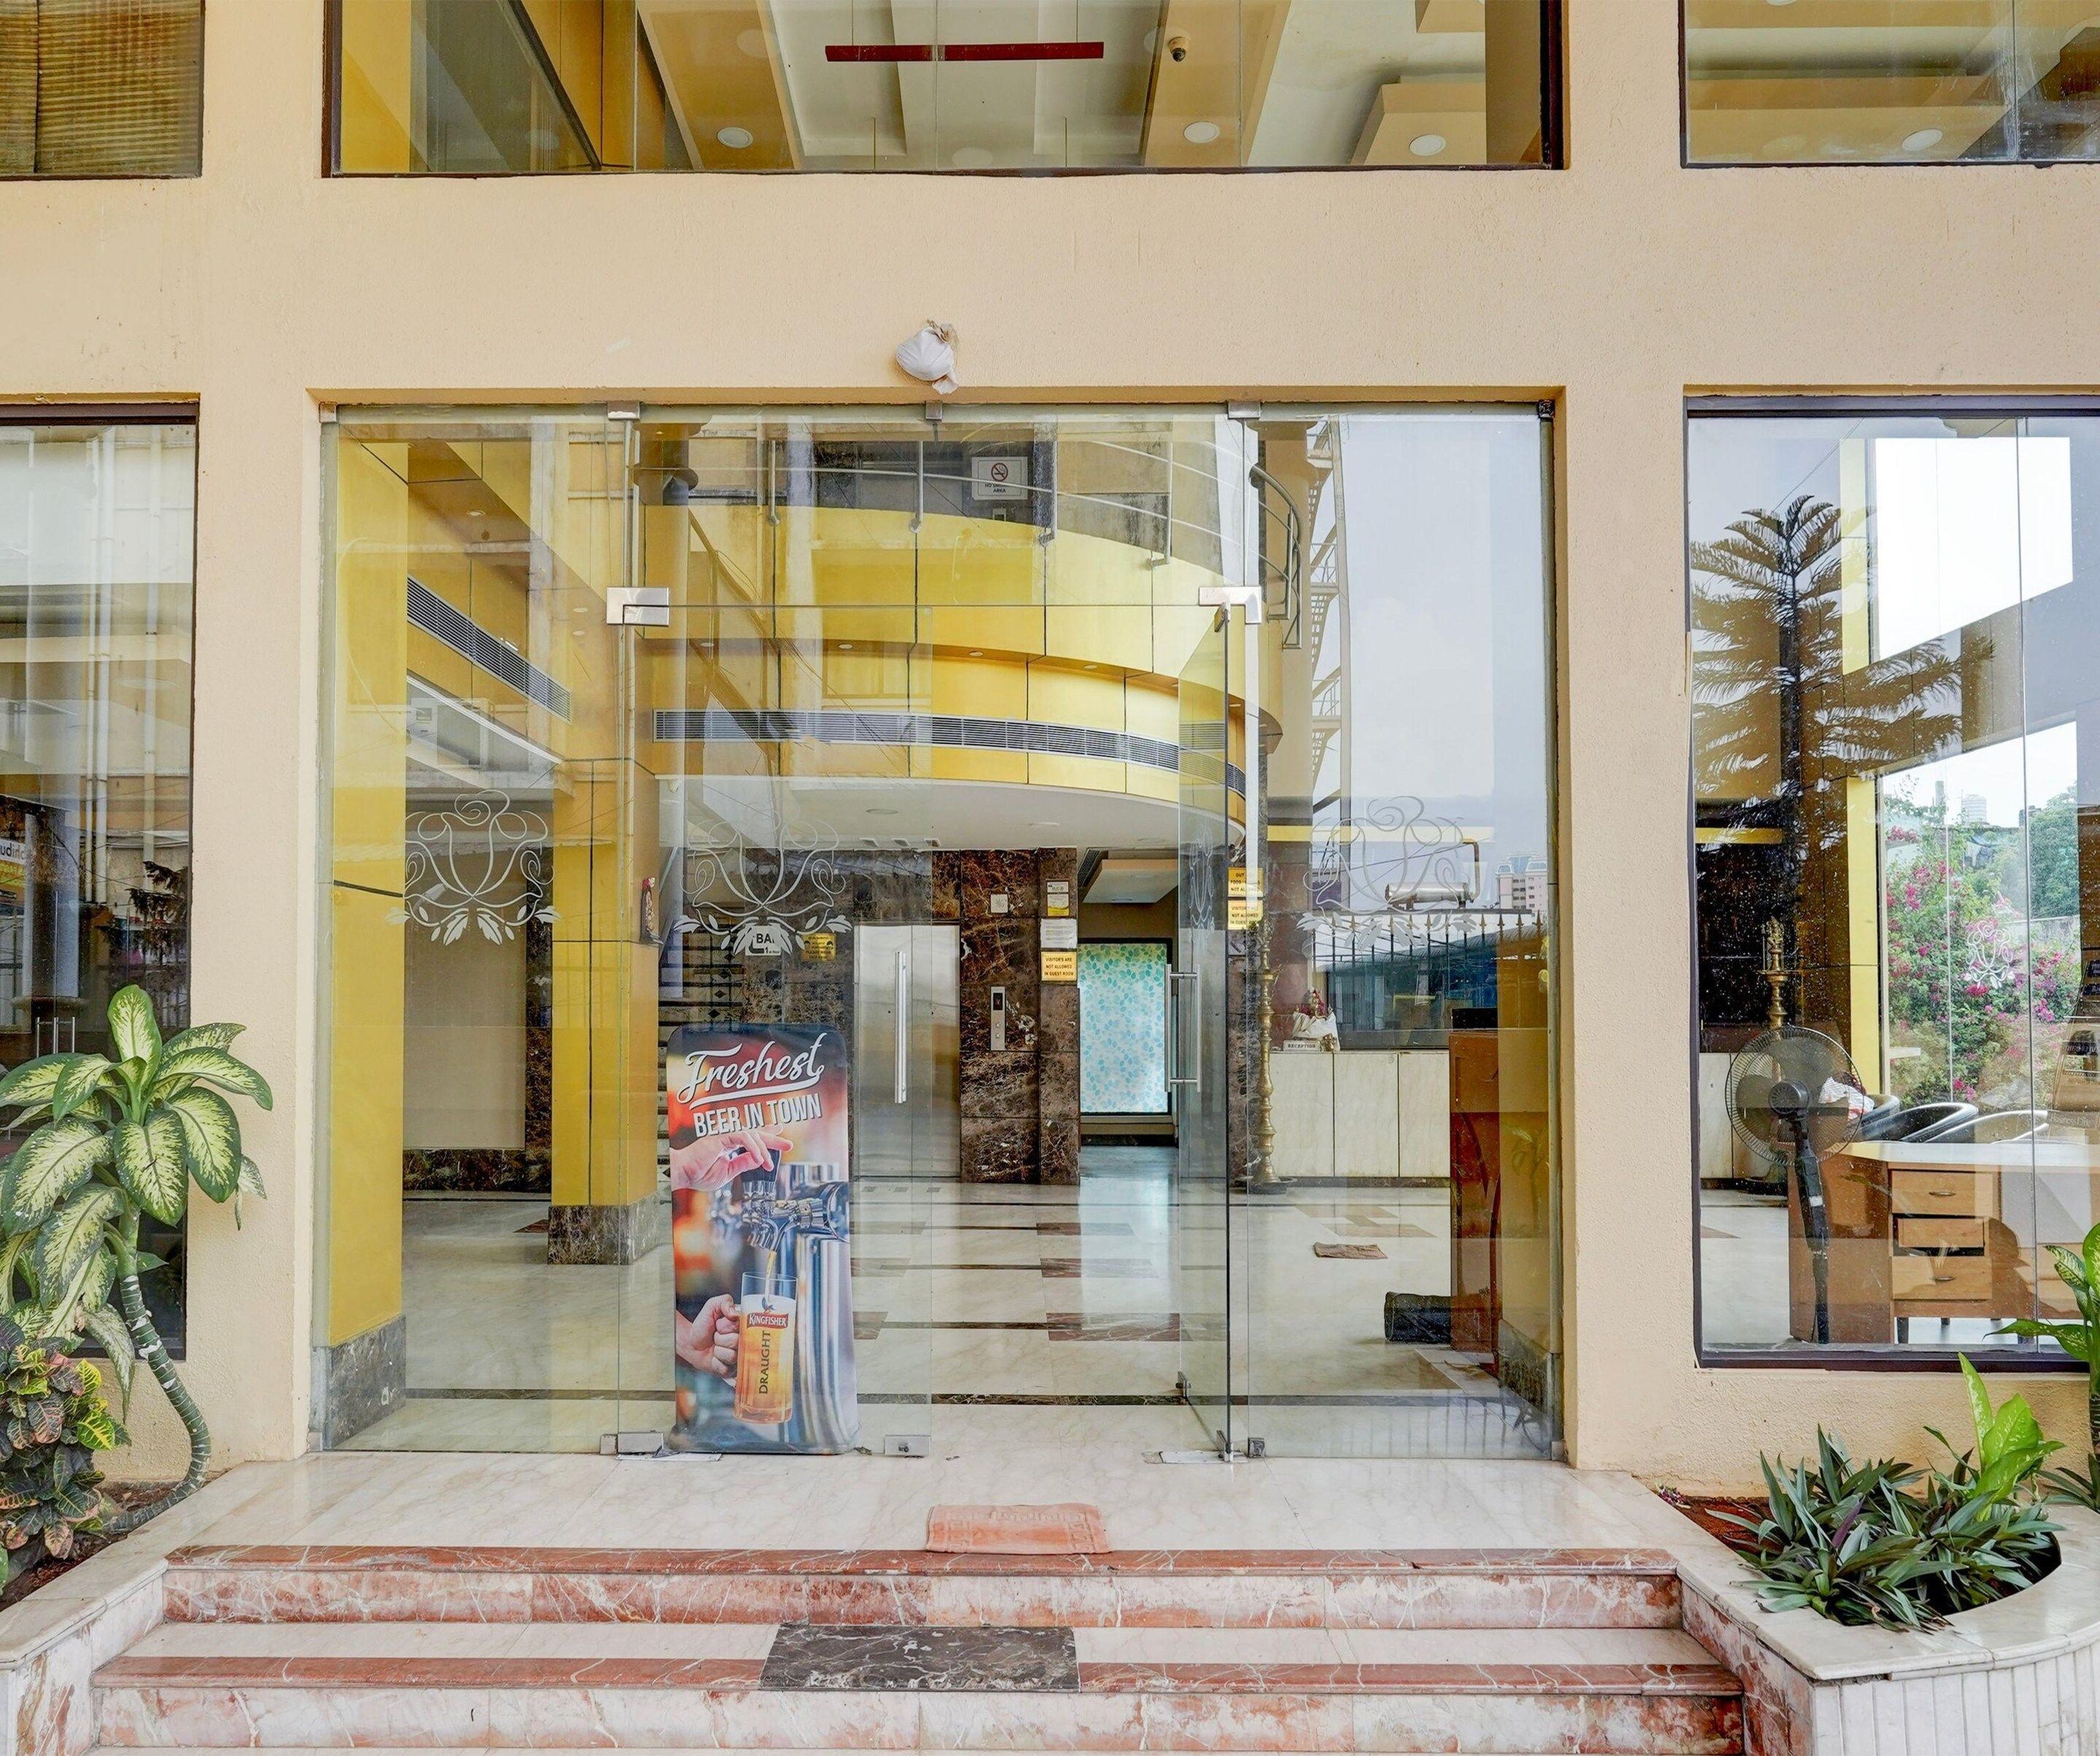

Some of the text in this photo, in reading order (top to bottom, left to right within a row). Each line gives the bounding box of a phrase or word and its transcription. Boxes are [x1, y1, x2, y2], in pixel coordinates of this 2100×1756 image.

[677, 1032, 828, 1104] Freshest
[693, 1093, 822, 1138] BEER IN TOWN
[749, 1313, 787, 1327] KINGFISHER
[759, 1330, 771, 1394] DRAUGHT
